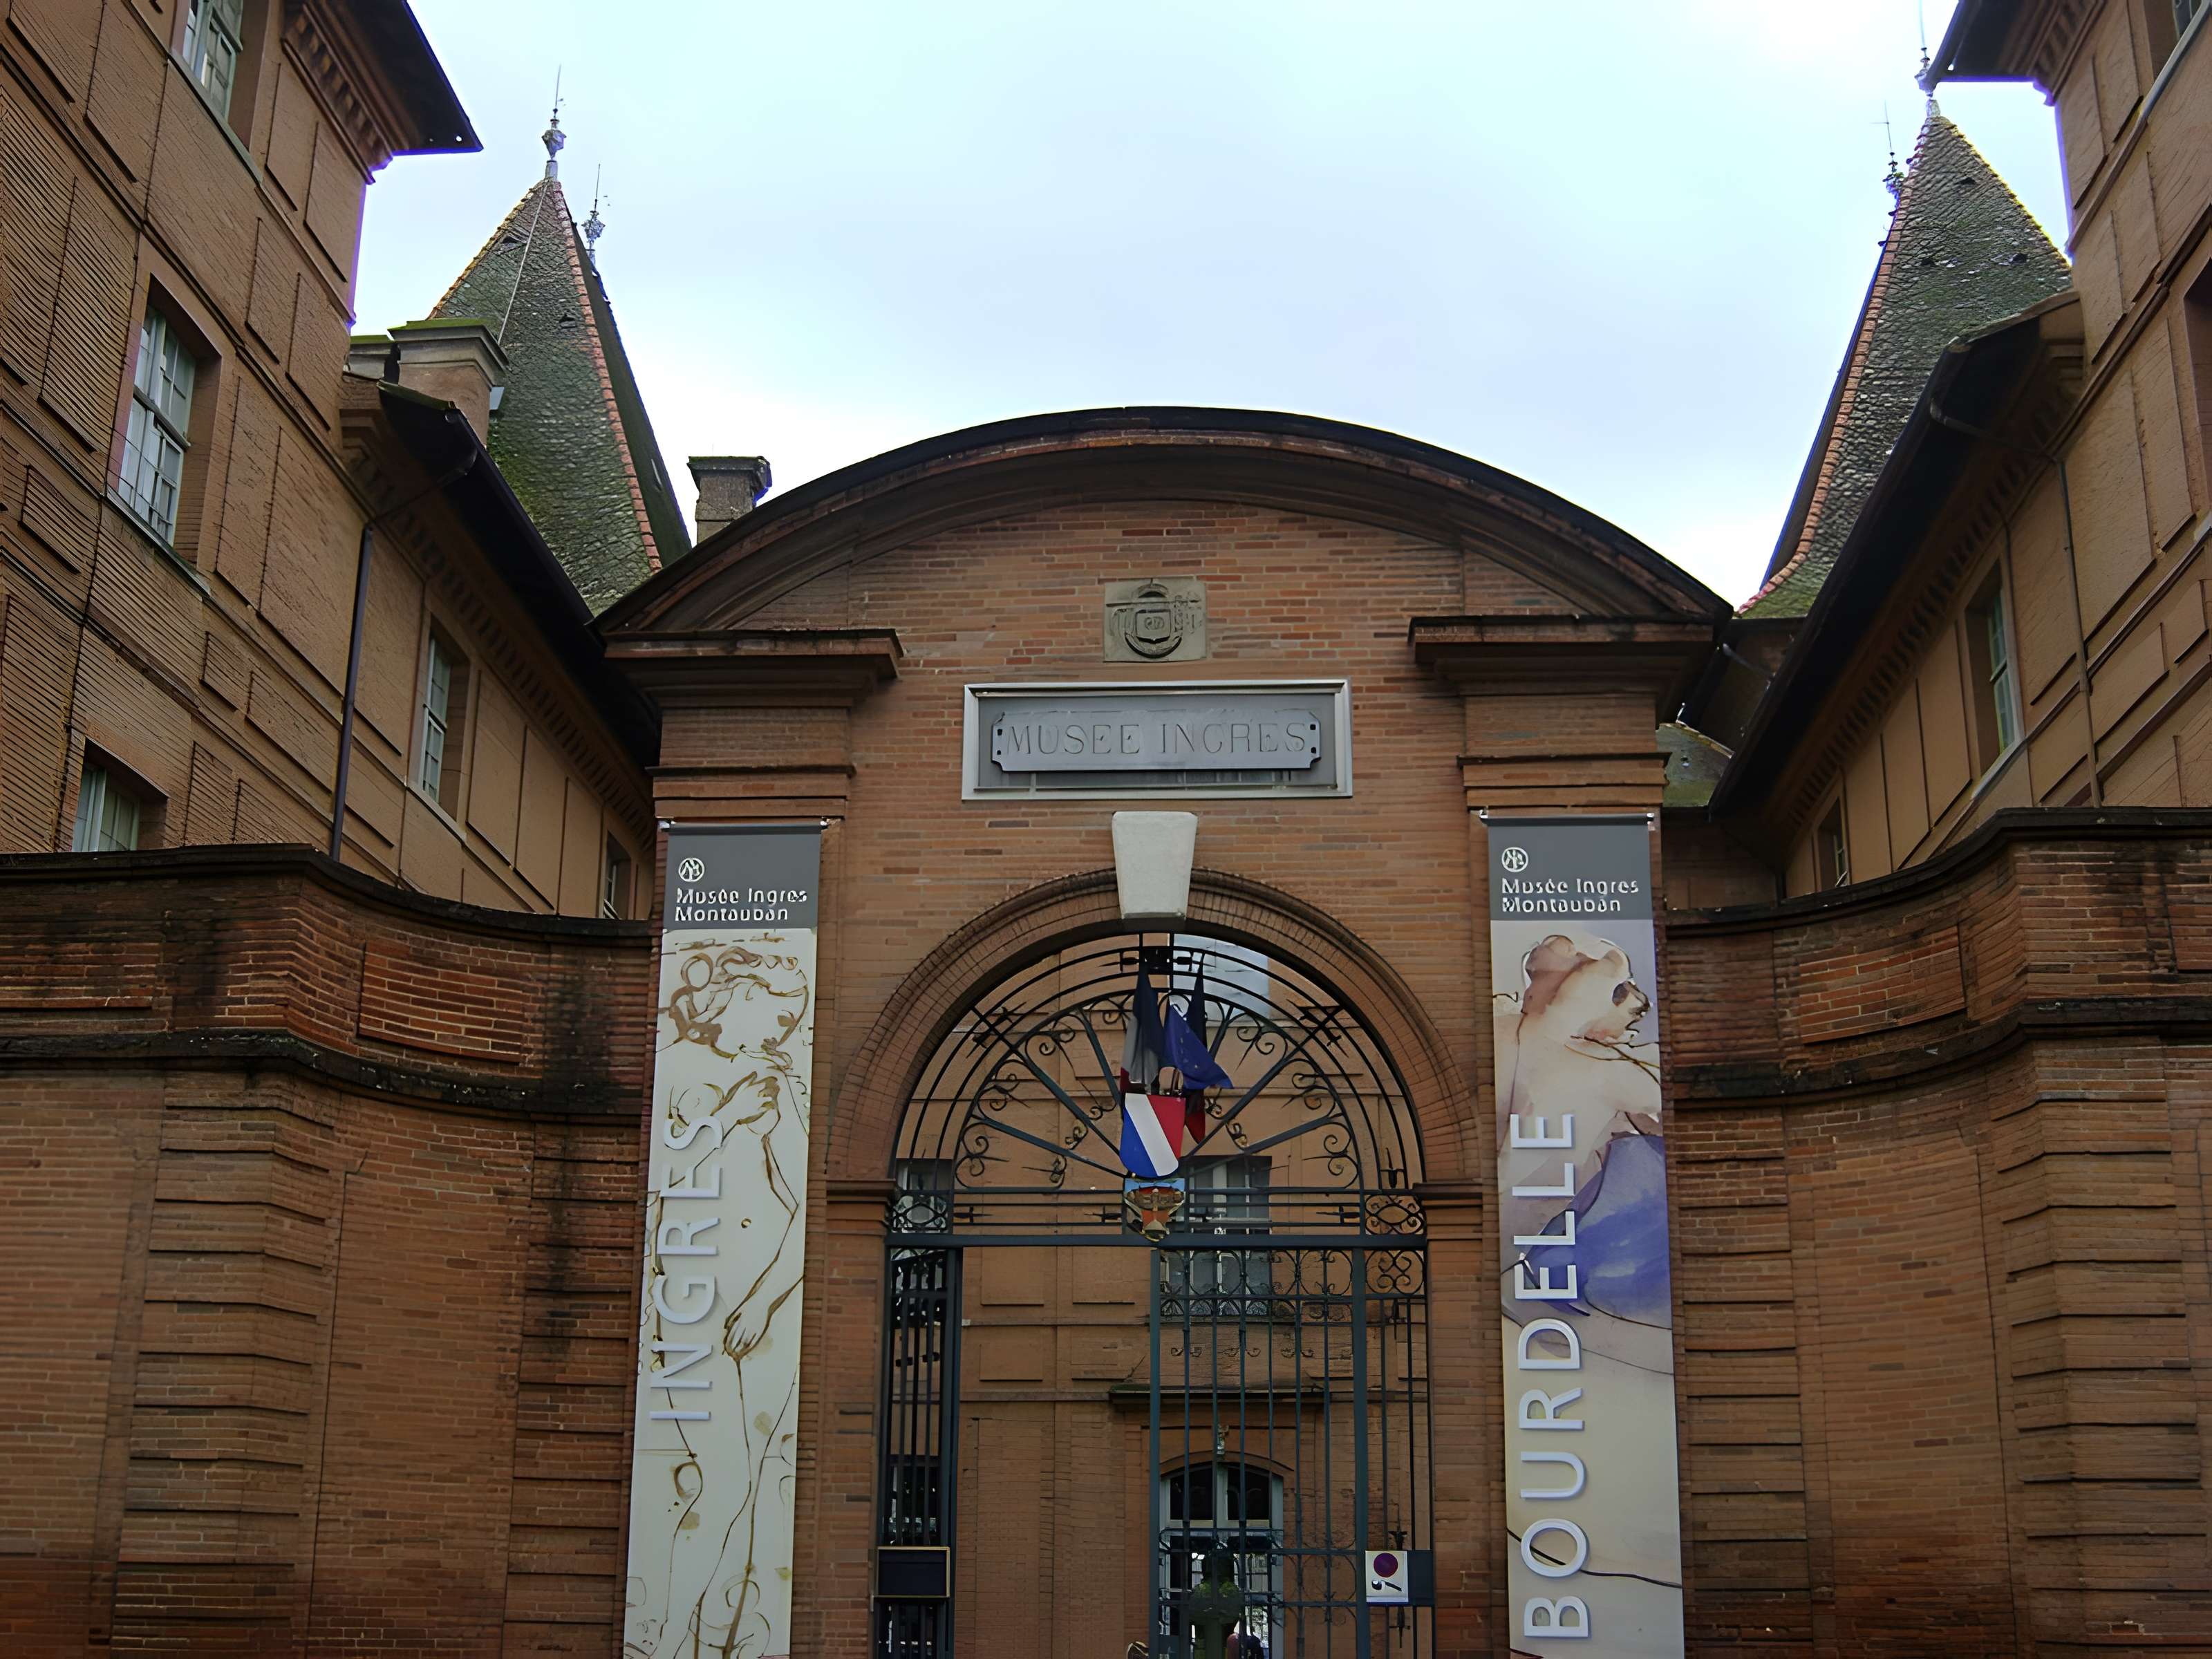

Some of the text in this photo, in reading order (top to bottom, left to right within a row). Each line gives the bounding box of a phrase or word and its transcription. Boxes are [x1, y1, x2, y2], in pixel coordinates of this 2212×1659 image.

[1160, 723, 1306, 753] INGRES
[1577, 878, 1639, 894] Ingres
[748, 888, 807, 906] Ingres
[1502, 897, 1621, 912] Montauban
[675, 906, 788, 921] Montauban
[649, 1115, 724, 1421] INGRES
[1510, 1113, 1591, 1638] BOURDELLE
